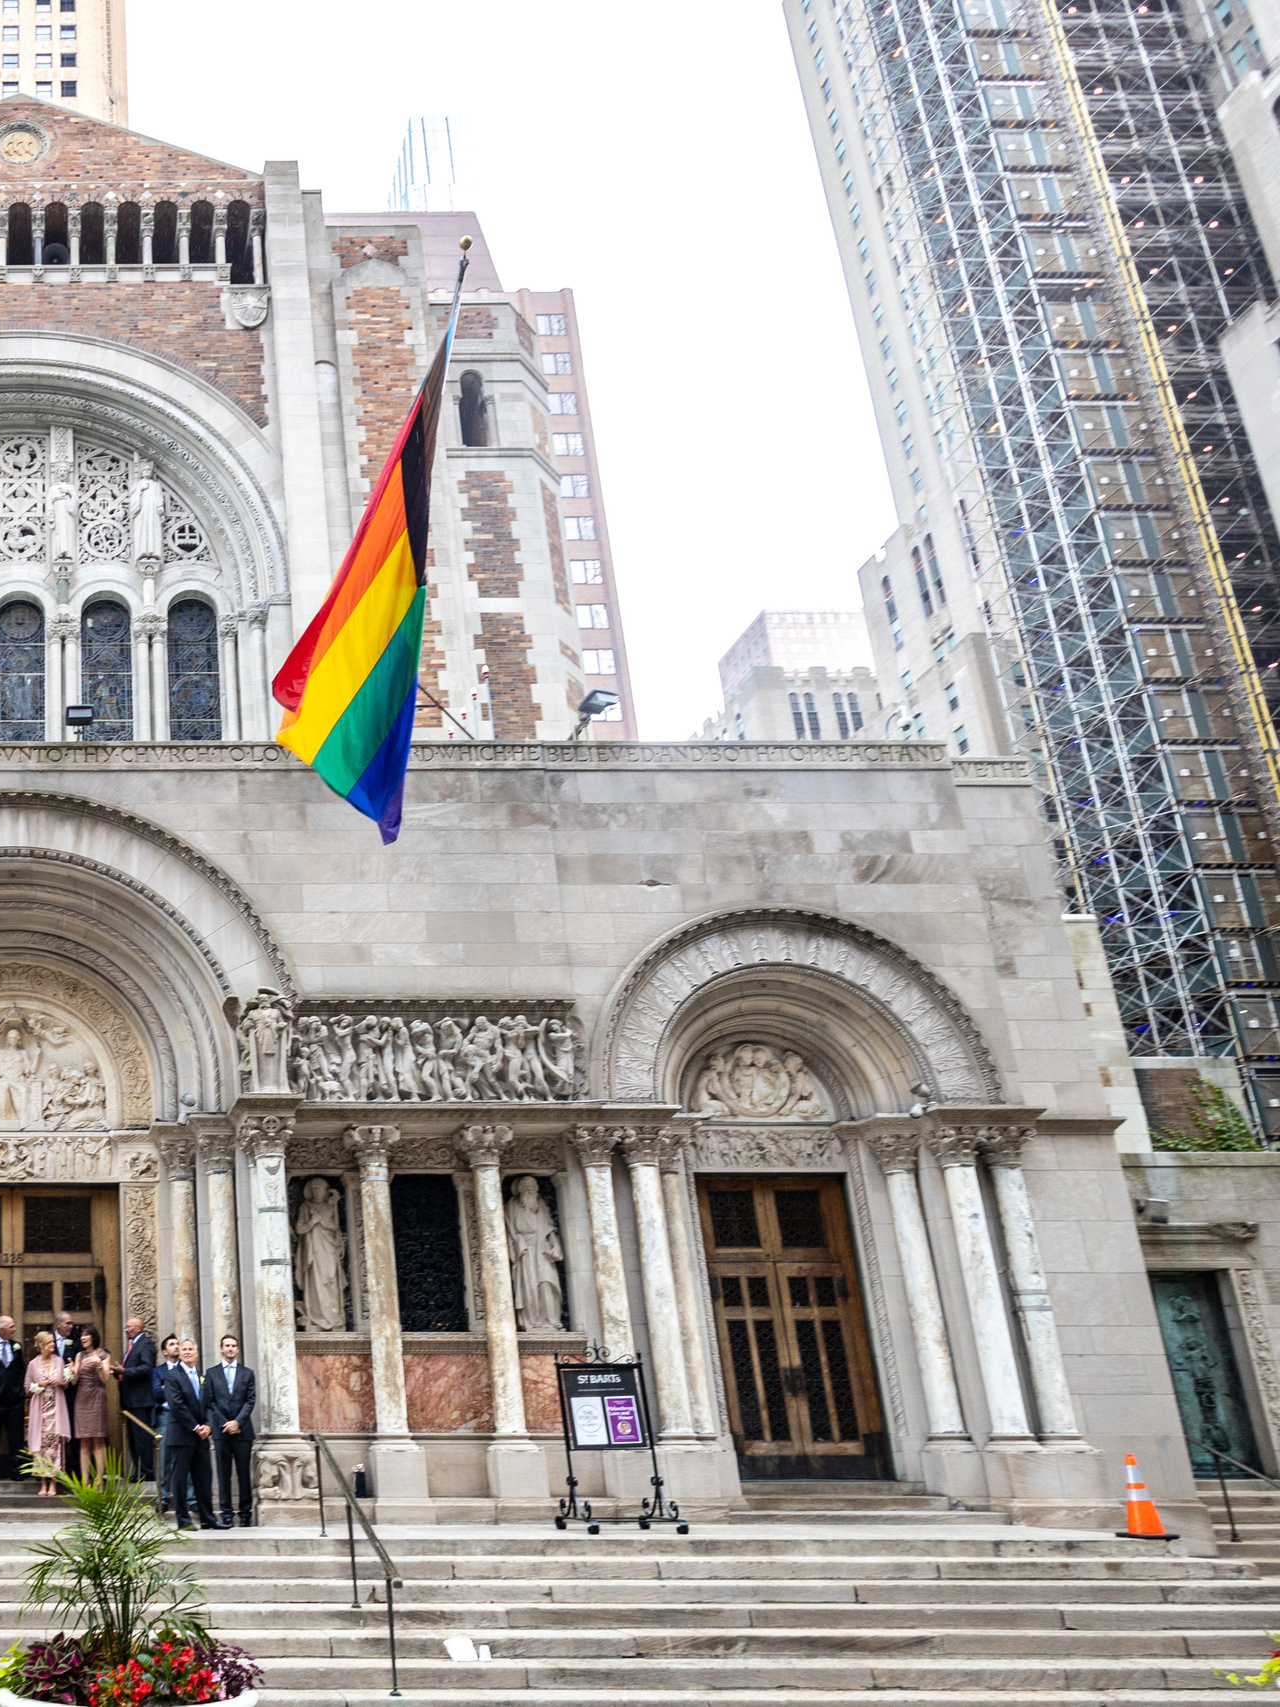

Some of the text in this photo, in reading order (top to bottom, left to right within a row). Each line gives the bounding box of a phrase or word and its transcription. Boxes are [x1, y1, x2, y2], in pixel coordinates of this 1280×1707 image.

[4, 748, 63, 763] VNTO
[67, 748, 116, 763] THY
[121, 748, 209, 763] CHVRCH
[216, 748, 246, 762] TO
[251, 747, 302, 762] LOV
[438, 746, 507, 762] WHICH
[512, 747, 540, 762] HE
[547, 747, 654, 762] BELIEVED
[660, 747, 705, 762] AND
[708, 747, 771, 762] BOTH
[775, 747, 806, 762] TO
[809, 747, 894, 762] PREACH
[897, 747, 945, 762] AND
